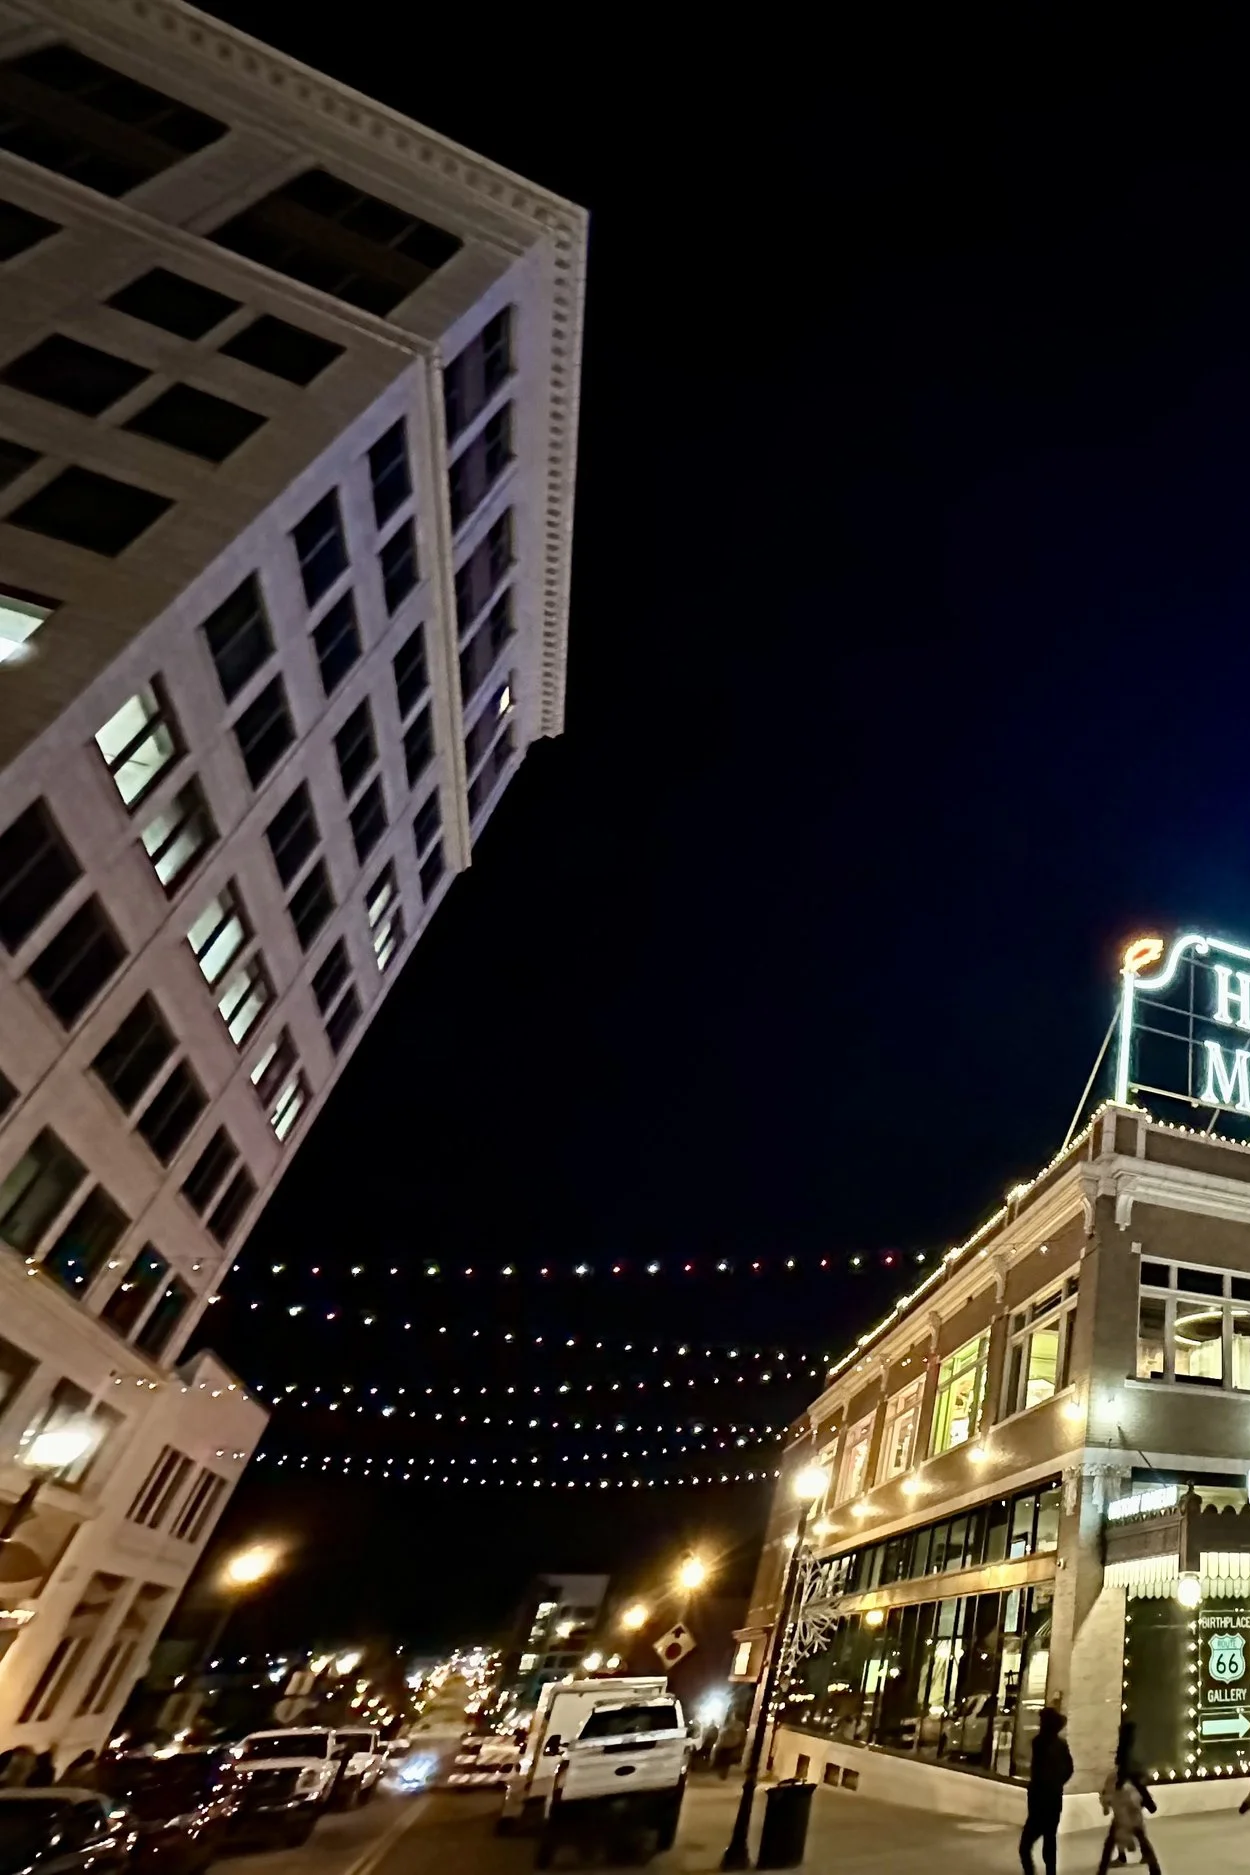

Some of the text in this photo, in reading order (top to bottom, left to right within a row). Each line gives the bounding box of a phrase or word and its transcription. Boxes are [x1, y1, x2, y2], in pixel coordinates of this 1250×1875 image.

[1202, 1616, 1250, 1629] BIRTHPLACE
[1217, 1639, 1237, 1648] ROUTE
[1216, 1653, 1239, 1674] 66
[1207, 1688, 1247, 1702] GALLERY
